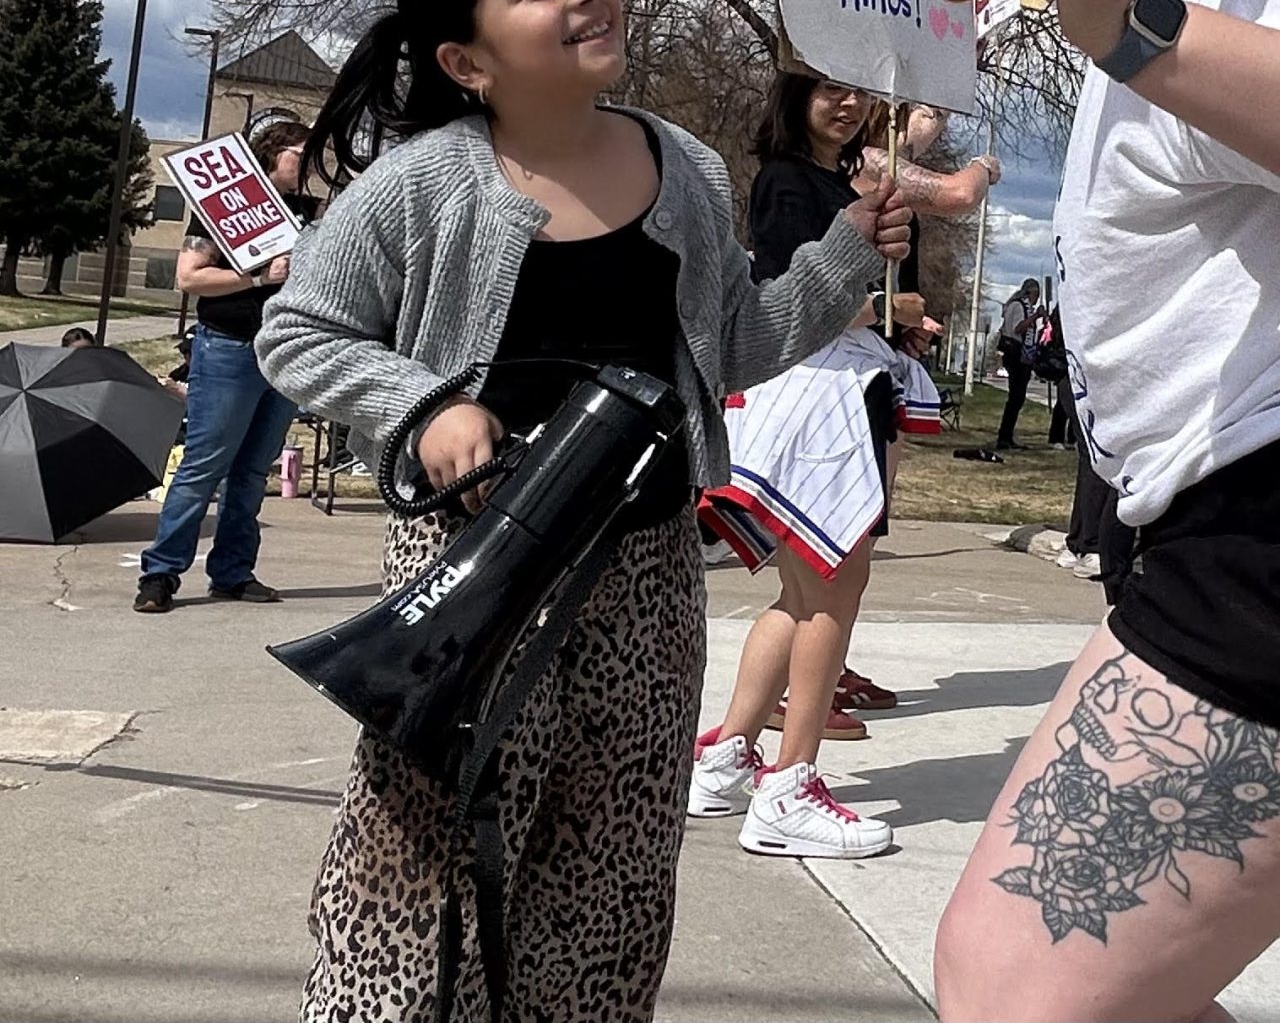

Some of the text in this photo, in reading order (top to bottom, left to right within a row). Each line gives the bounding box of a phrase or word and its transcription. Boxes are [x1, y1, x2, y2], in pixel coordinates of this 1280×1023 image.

[184, 145, 248, 190] SEA
[219, 186, 250, 212] ON
[219, 199, 282, 240] STRIKE
[399, 564, 463, 626] PYLE
